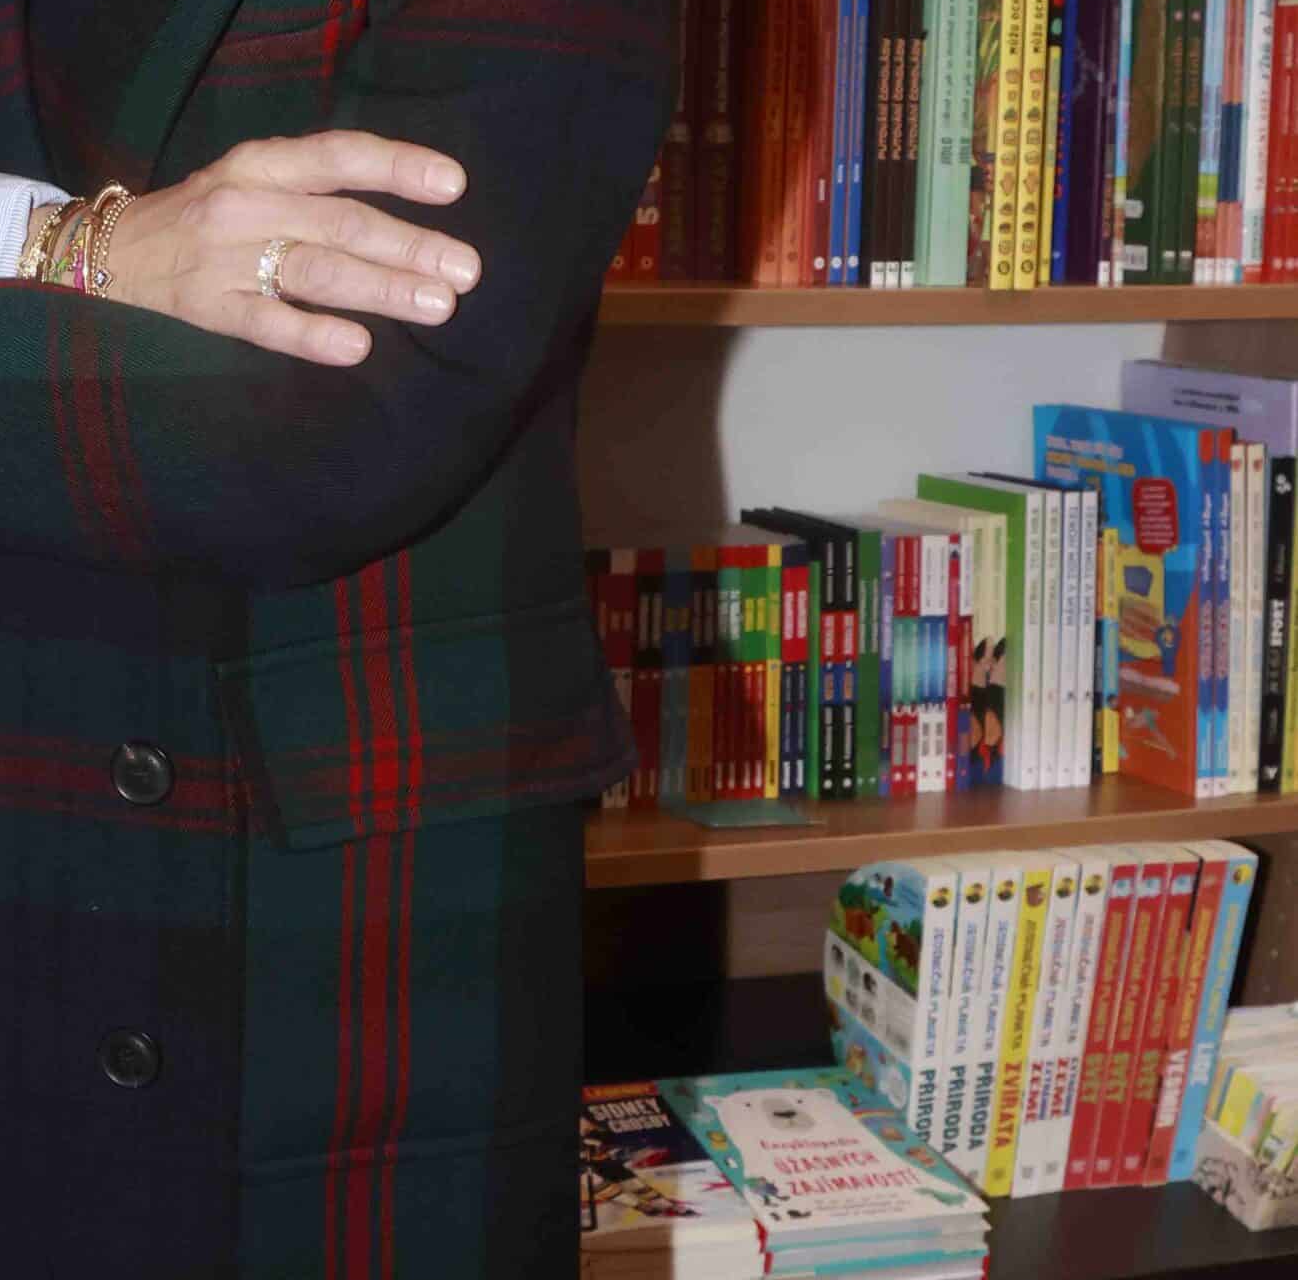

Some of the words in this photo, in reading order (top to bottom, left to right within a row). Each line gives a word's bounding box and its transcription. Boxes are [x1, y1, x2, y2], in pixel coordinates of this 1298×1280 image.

[1268, 599, 1285, 647] SPORT
[588, 1097, 662, 1122] SIDNEY
[915, 1068, 938, 1142] PŘÍROD
[941, 1064, 967, 1154] PŘÍRODA
[967, 1061, 994, 1151] PŘÍRODA
[994, 1061, 1023, 1150] ZVÍŘATA
